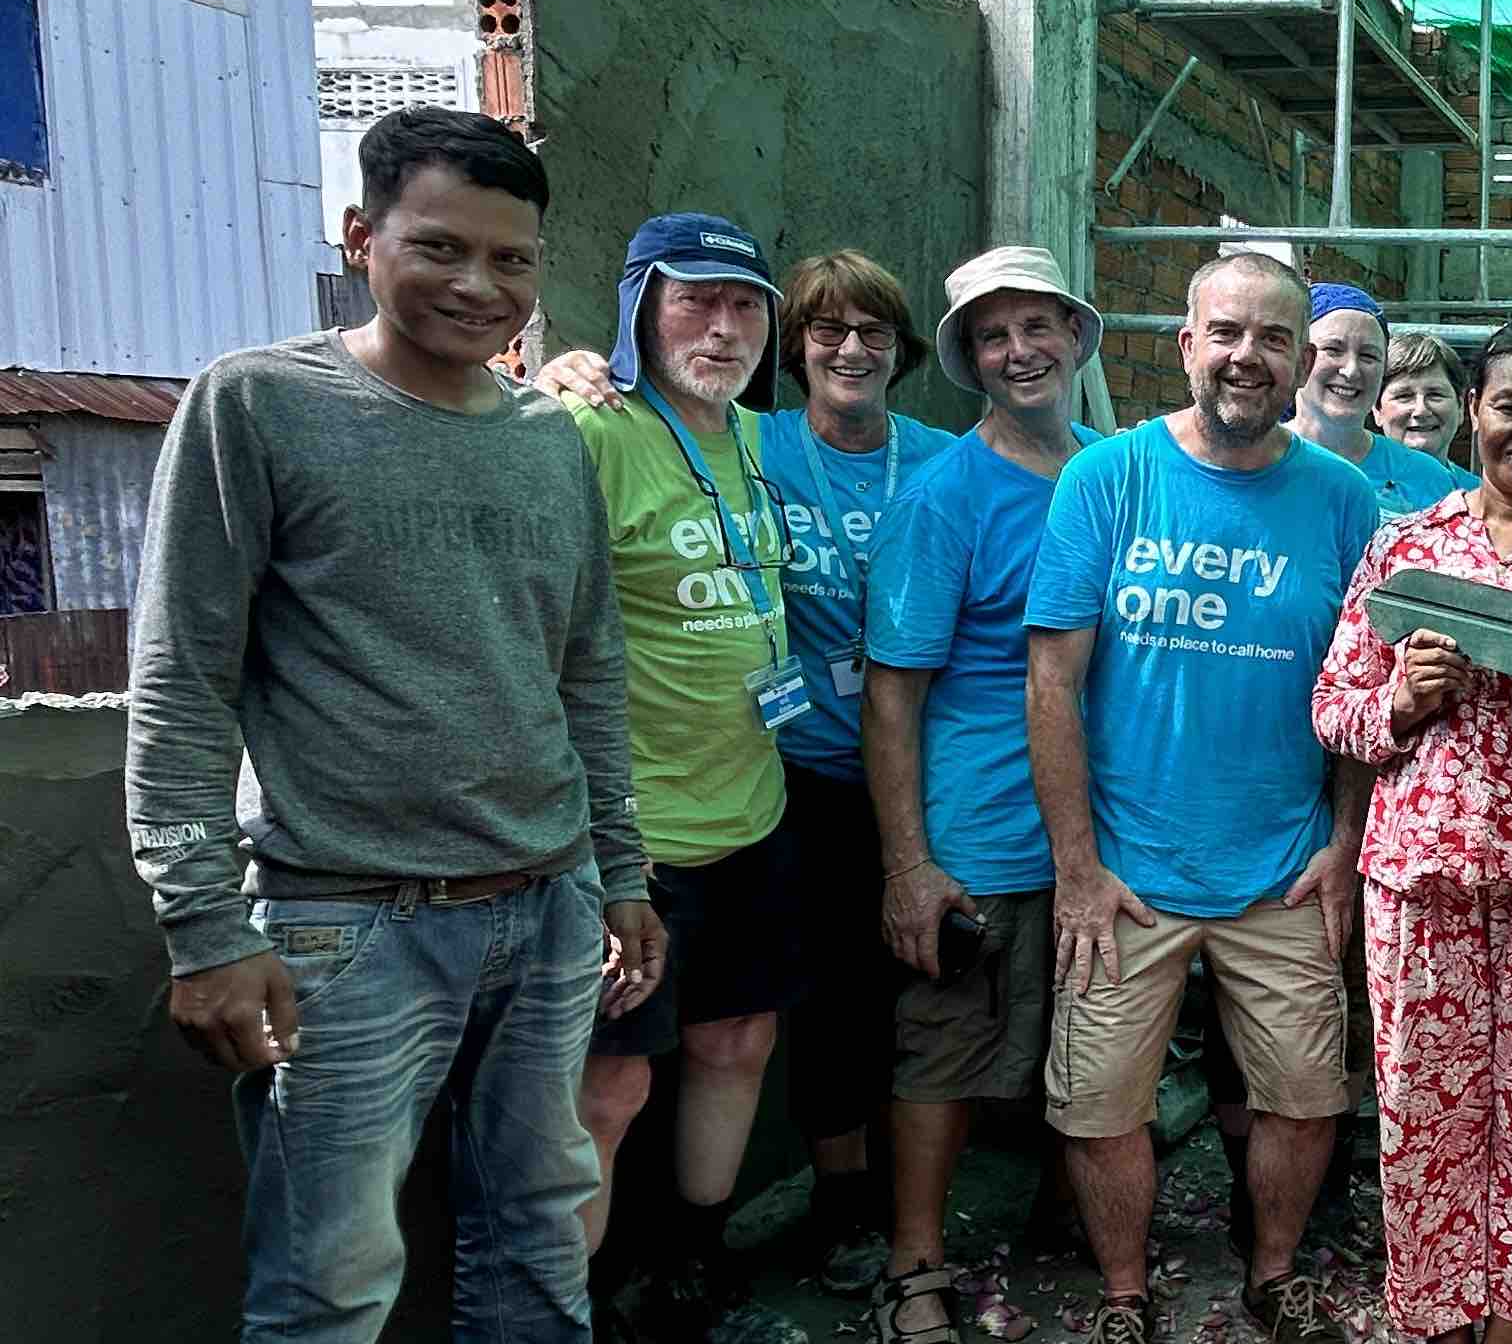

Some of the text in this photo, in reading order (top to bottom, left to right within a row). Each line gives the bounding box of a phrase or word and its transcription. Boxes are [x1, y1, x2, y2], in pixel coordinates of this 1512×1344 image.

[783, 503, 882, 543] eve
[782, 539, 869, 580] on
[1125, 536, 1289, 598] every
[677, 567, 753, 609] on
[1116, 584, 1228, 631] one
[682, 614, 734, 632] needs
[1120, 631, 1296, 661] needs a place to call home
